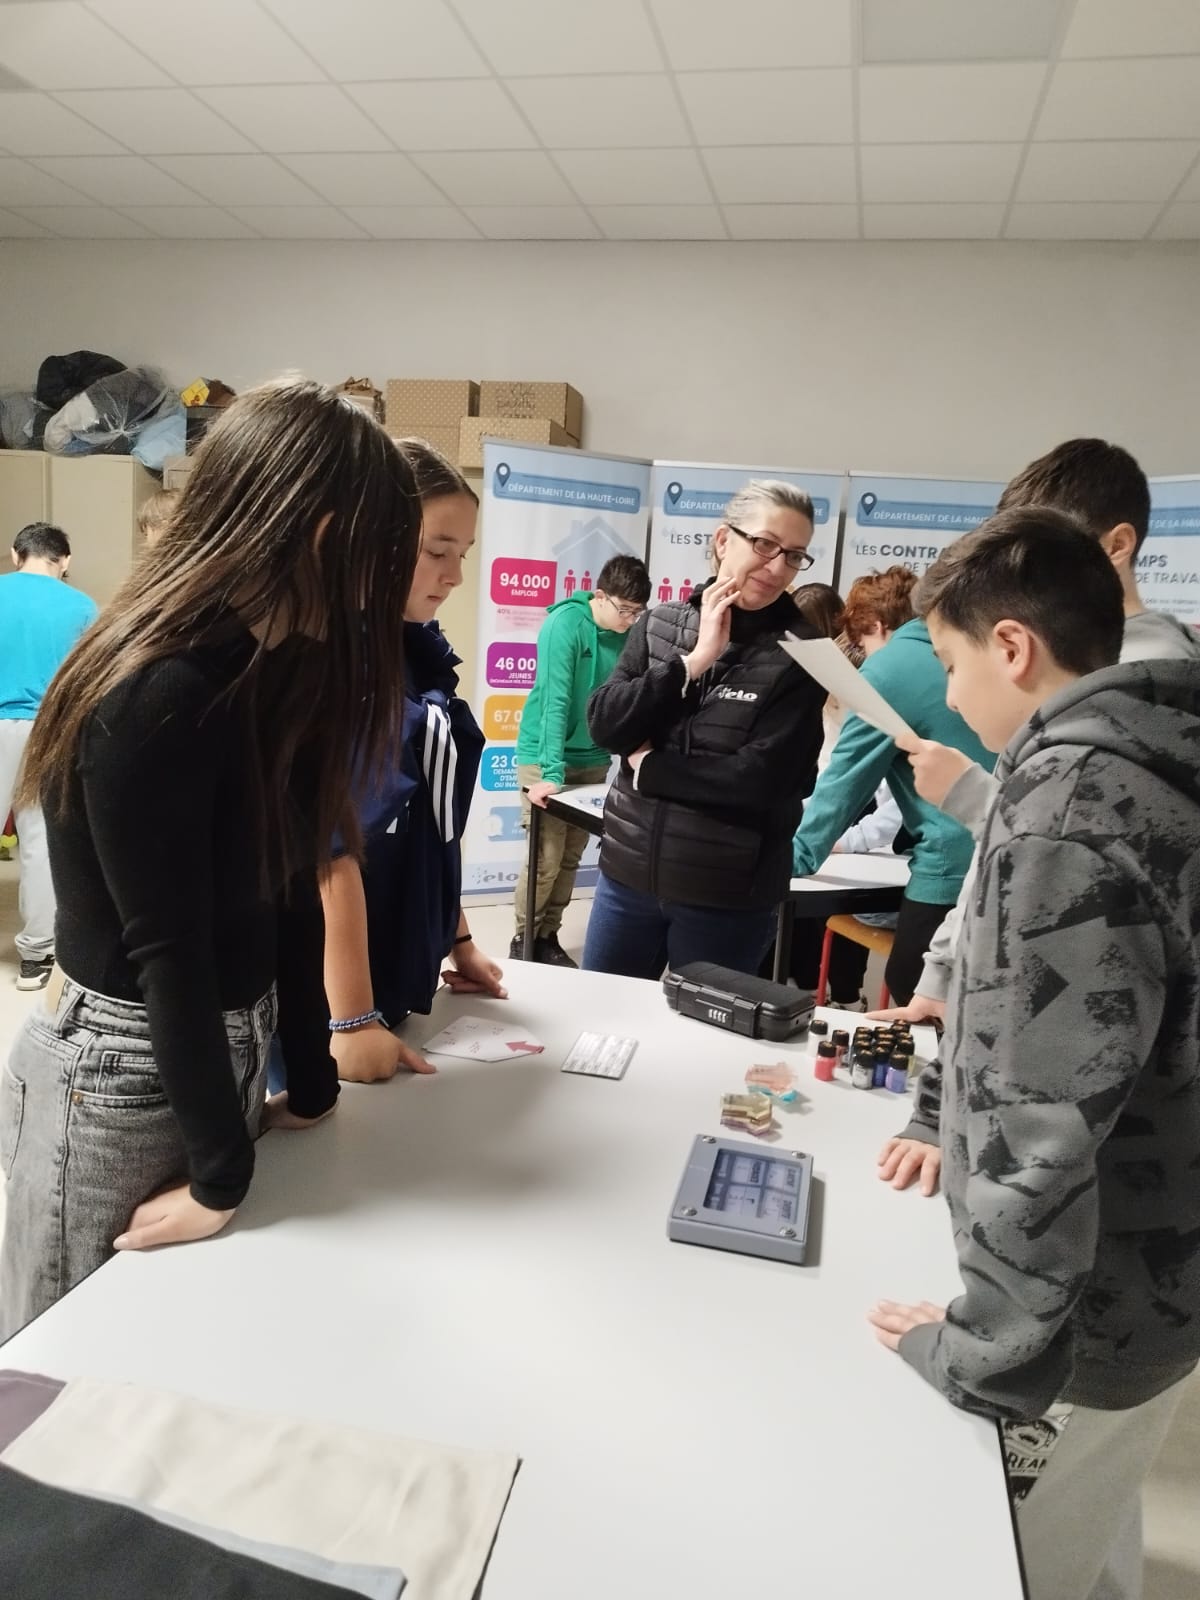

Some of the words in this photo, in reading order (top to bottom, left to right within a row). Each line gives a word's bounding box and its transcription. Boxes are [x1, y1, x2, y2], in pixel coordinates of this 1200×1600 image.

[508, 483, 563, 497] DÉPARTEMENT
[565, 490, 575, 499] DE
[576, 491, 586, 500] LA
[587, 493, 636, 506] HAUTE-LOIRE
[680, 500, 725, 511] DÉPARTEM
[873, 510, 936, 522] DÉPARTEMENT
[938, 514, 950, 523] DE
[951, 514, 962, 524] LA
[670, 533, 691, 545] LES
[693, 533, 713, 546] ST
[856, 545, 877, 556] LES
[1137, 554, 1168, 568] MPS
[500, 572, 519, 587] 94
[522, 574, 550, 590] 000
[1153, 572, 1199, 585] TRAVA
[511, 589, 538, 597] EMPLOIS
[495, 657, 514, 671] 46
[517, 657, 537, 672] 00
[508, 672, 533, 680] JEUNES
[494, 709, 511, 723] 67
[514, 709, 524, 723] 0
[491, 755, 508, 768] 23
